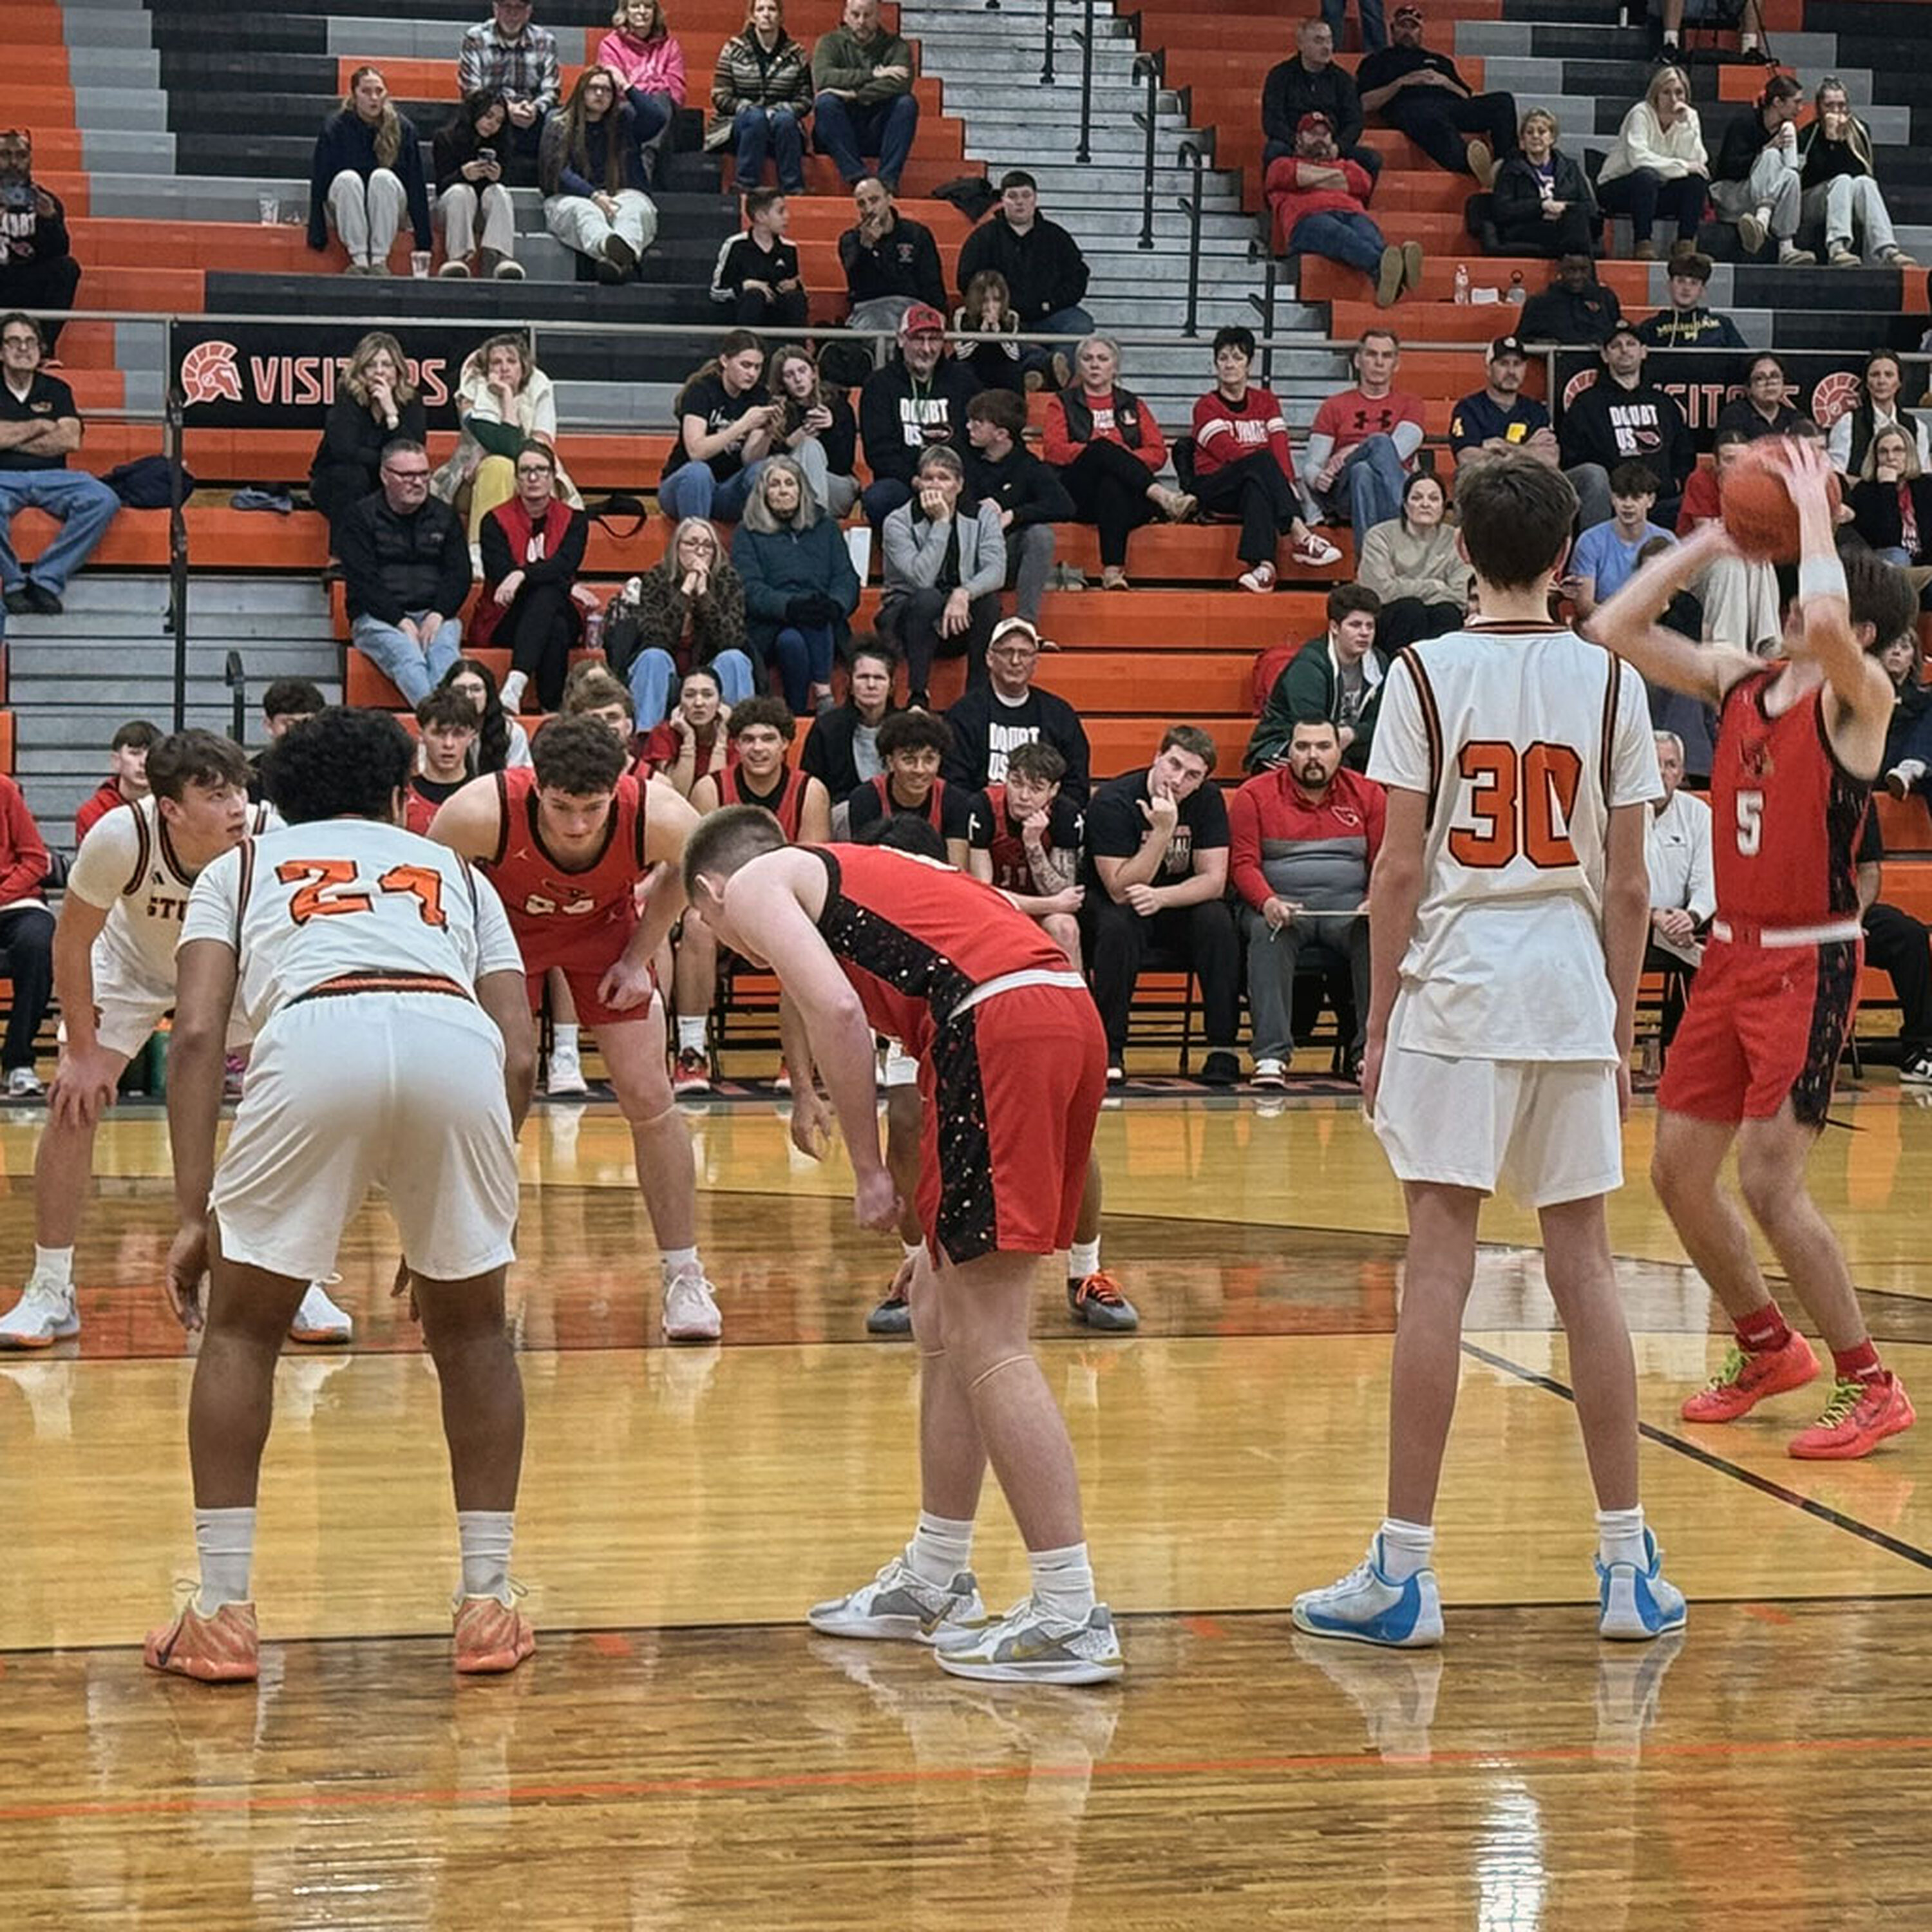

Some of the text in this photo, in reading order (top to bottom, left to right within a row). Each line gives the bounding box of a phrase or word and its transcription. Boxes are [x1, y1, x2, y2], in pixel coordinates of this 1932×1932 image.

[900, 398, 949, 424] DOUBT
[1609, 404, 1658, 427] DOUBT
[1615, 426, 1636, 450] US
[1448, 739, 1583, 869] 30
[1736, 789, 1765, 857] 5
